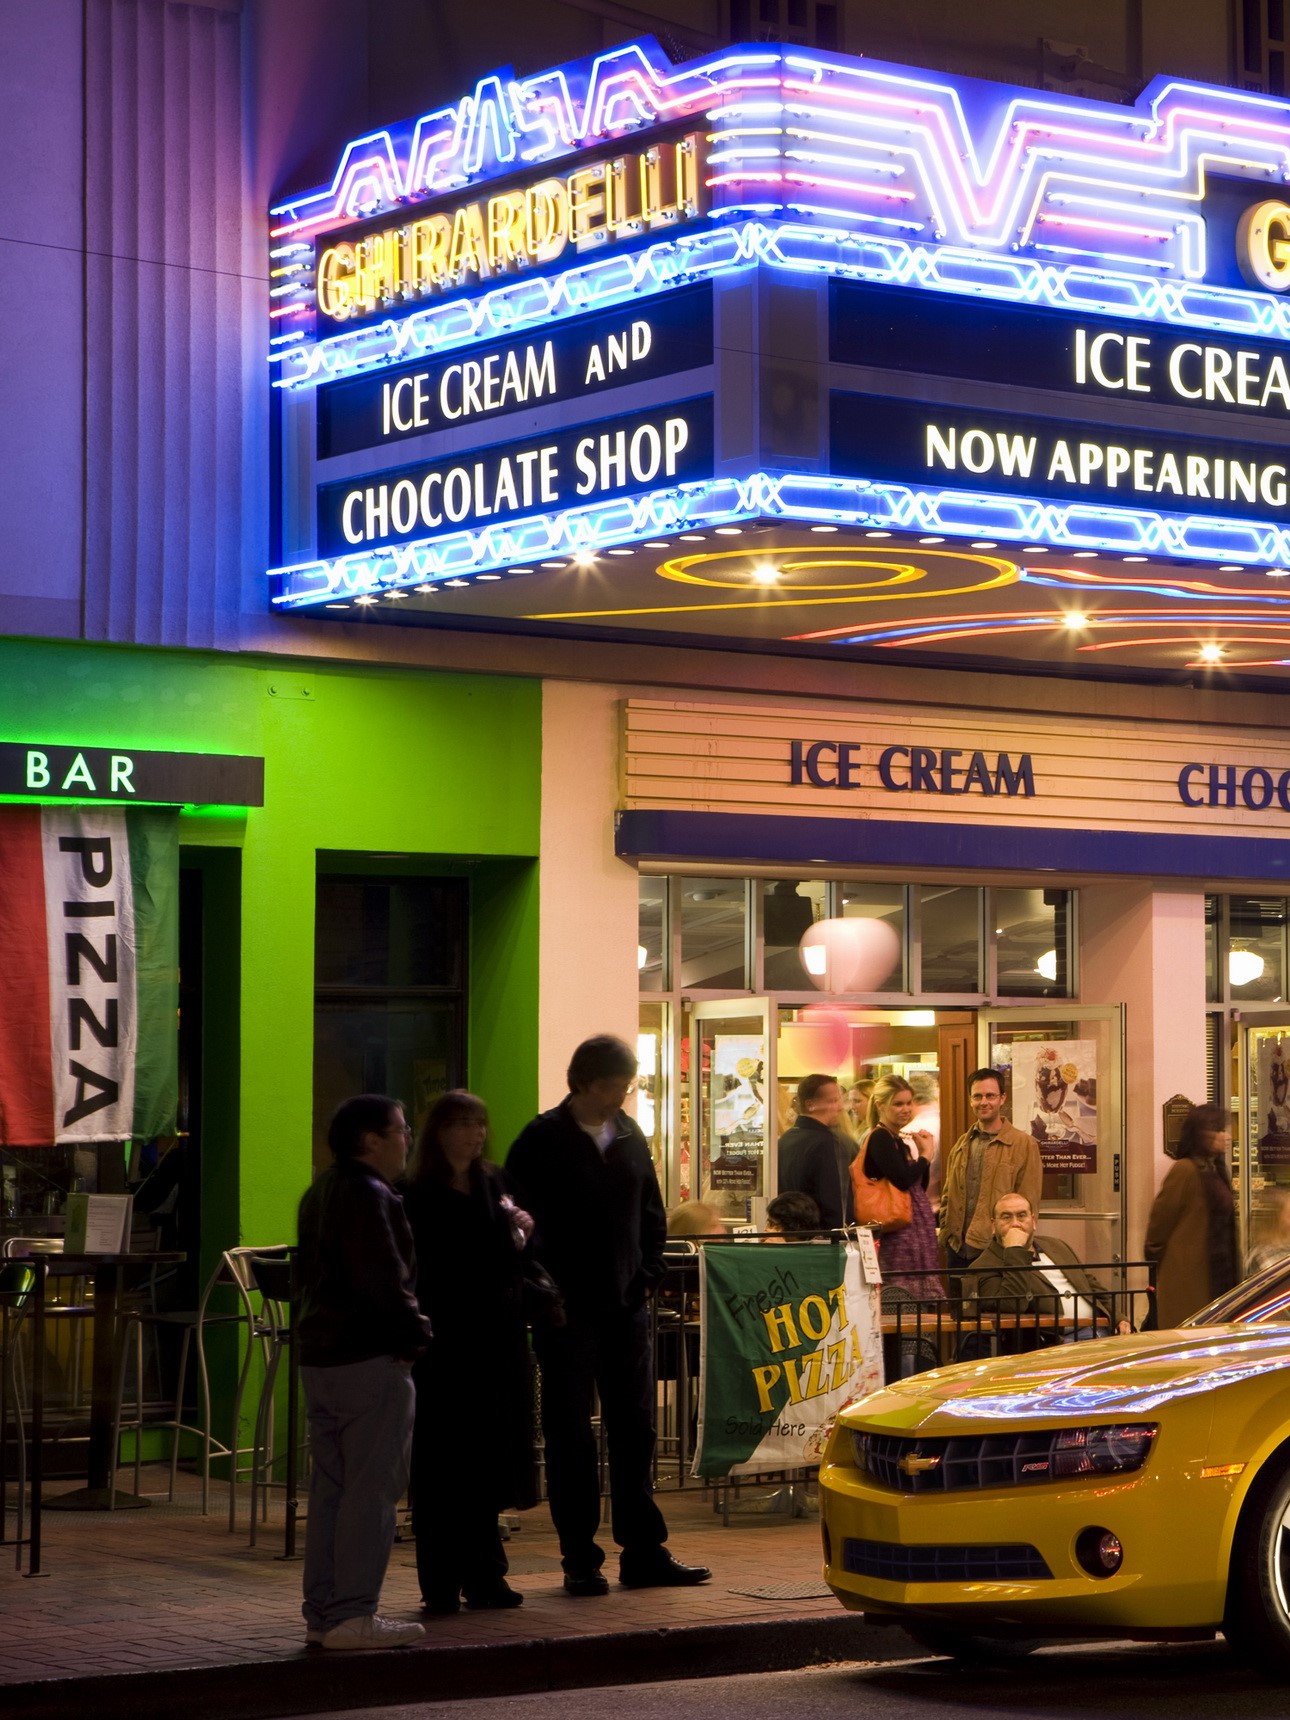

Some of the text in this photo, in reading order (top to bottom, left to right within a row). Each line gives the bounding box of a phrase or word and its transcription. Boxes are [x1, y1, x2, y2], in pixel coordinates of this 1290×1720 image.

[316, 132, 703, 321] GHIRARDELLI
[382, 320, 652, 437] ICE CREAM AND
[1074, 328, 1151, 393] ICE
[341, 417, 689, 545] CHOCOLATE SHOP
[925, 424, 1037, 478] NOW
[26, 750, 136, 793] BAR
[790, 740, 861, 789] ICE
[879, 746, 1036, 797] CREAM
[58, 836, 119, 1129] PIZZA
[727, 1266, 799, 1329] Fresh
[760, 1282, 851, 1354] HOT
[751, 1324, 864, 1414] PIZZA
[724, 1415, 806, 1437] Sold Here
